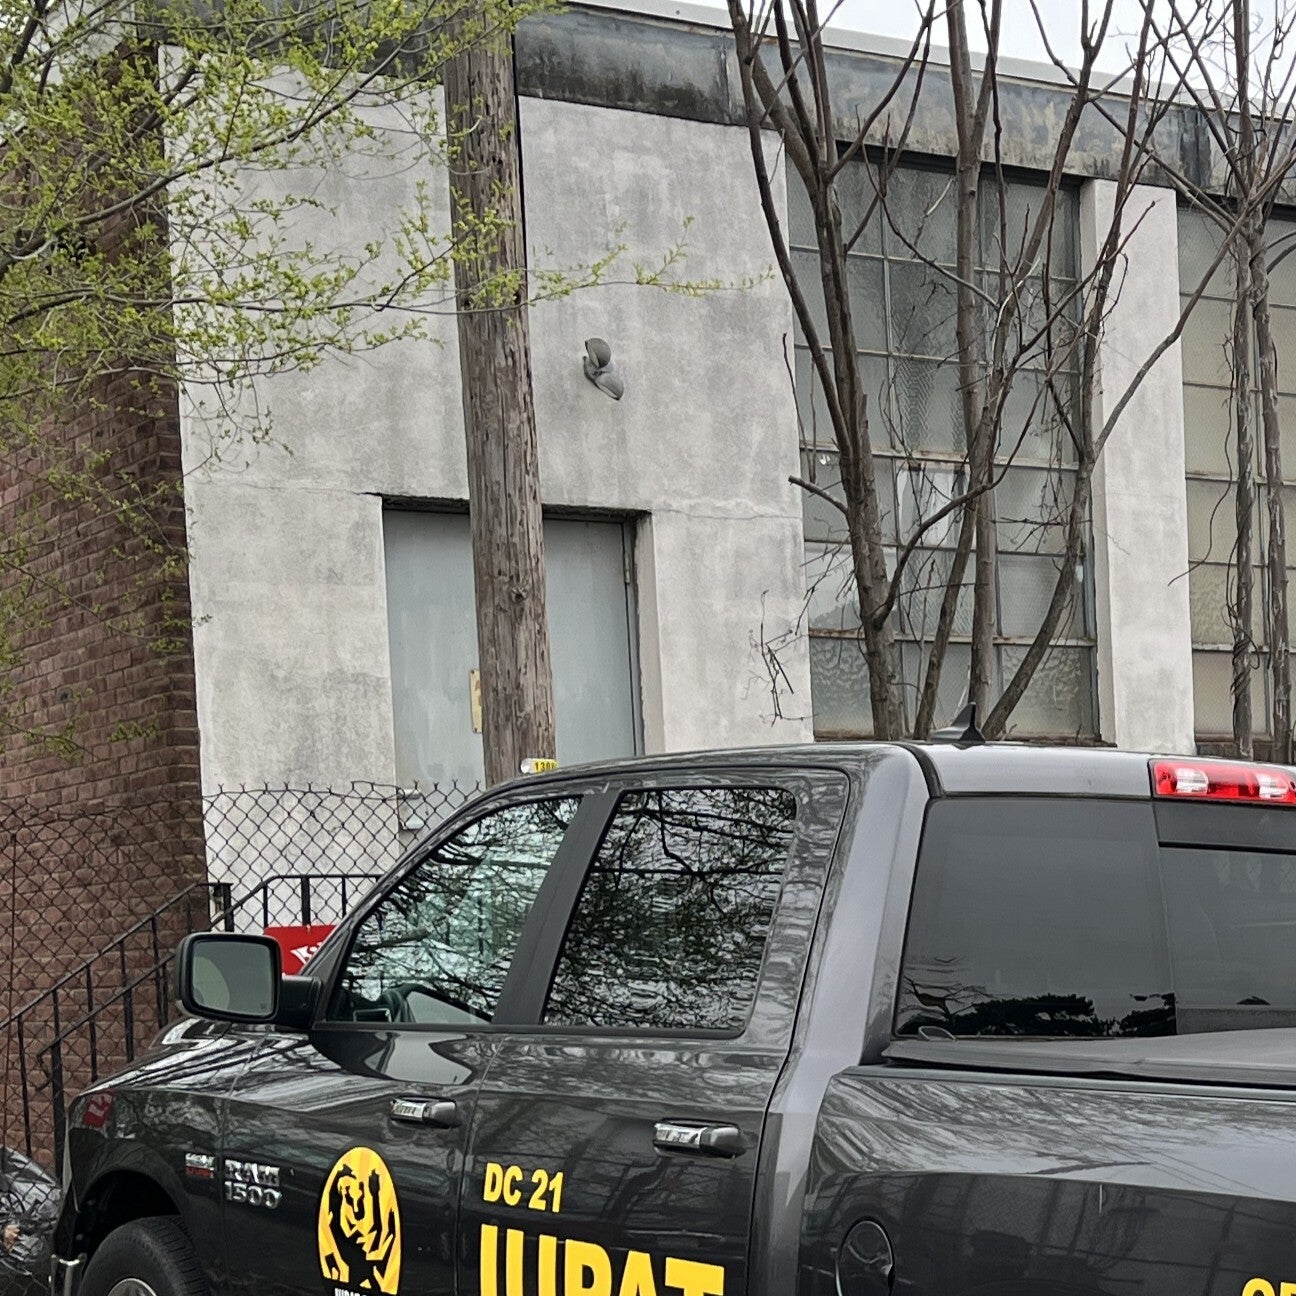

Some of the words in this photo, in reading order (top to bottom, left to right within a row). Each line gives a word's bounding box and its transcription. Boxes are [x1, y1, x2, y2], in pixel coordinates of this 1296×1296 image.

[224, 1180, 283, 1210] 1500
[483, 1162, 524, 1207] DC
[528, 1168, 564, 1213] 21
